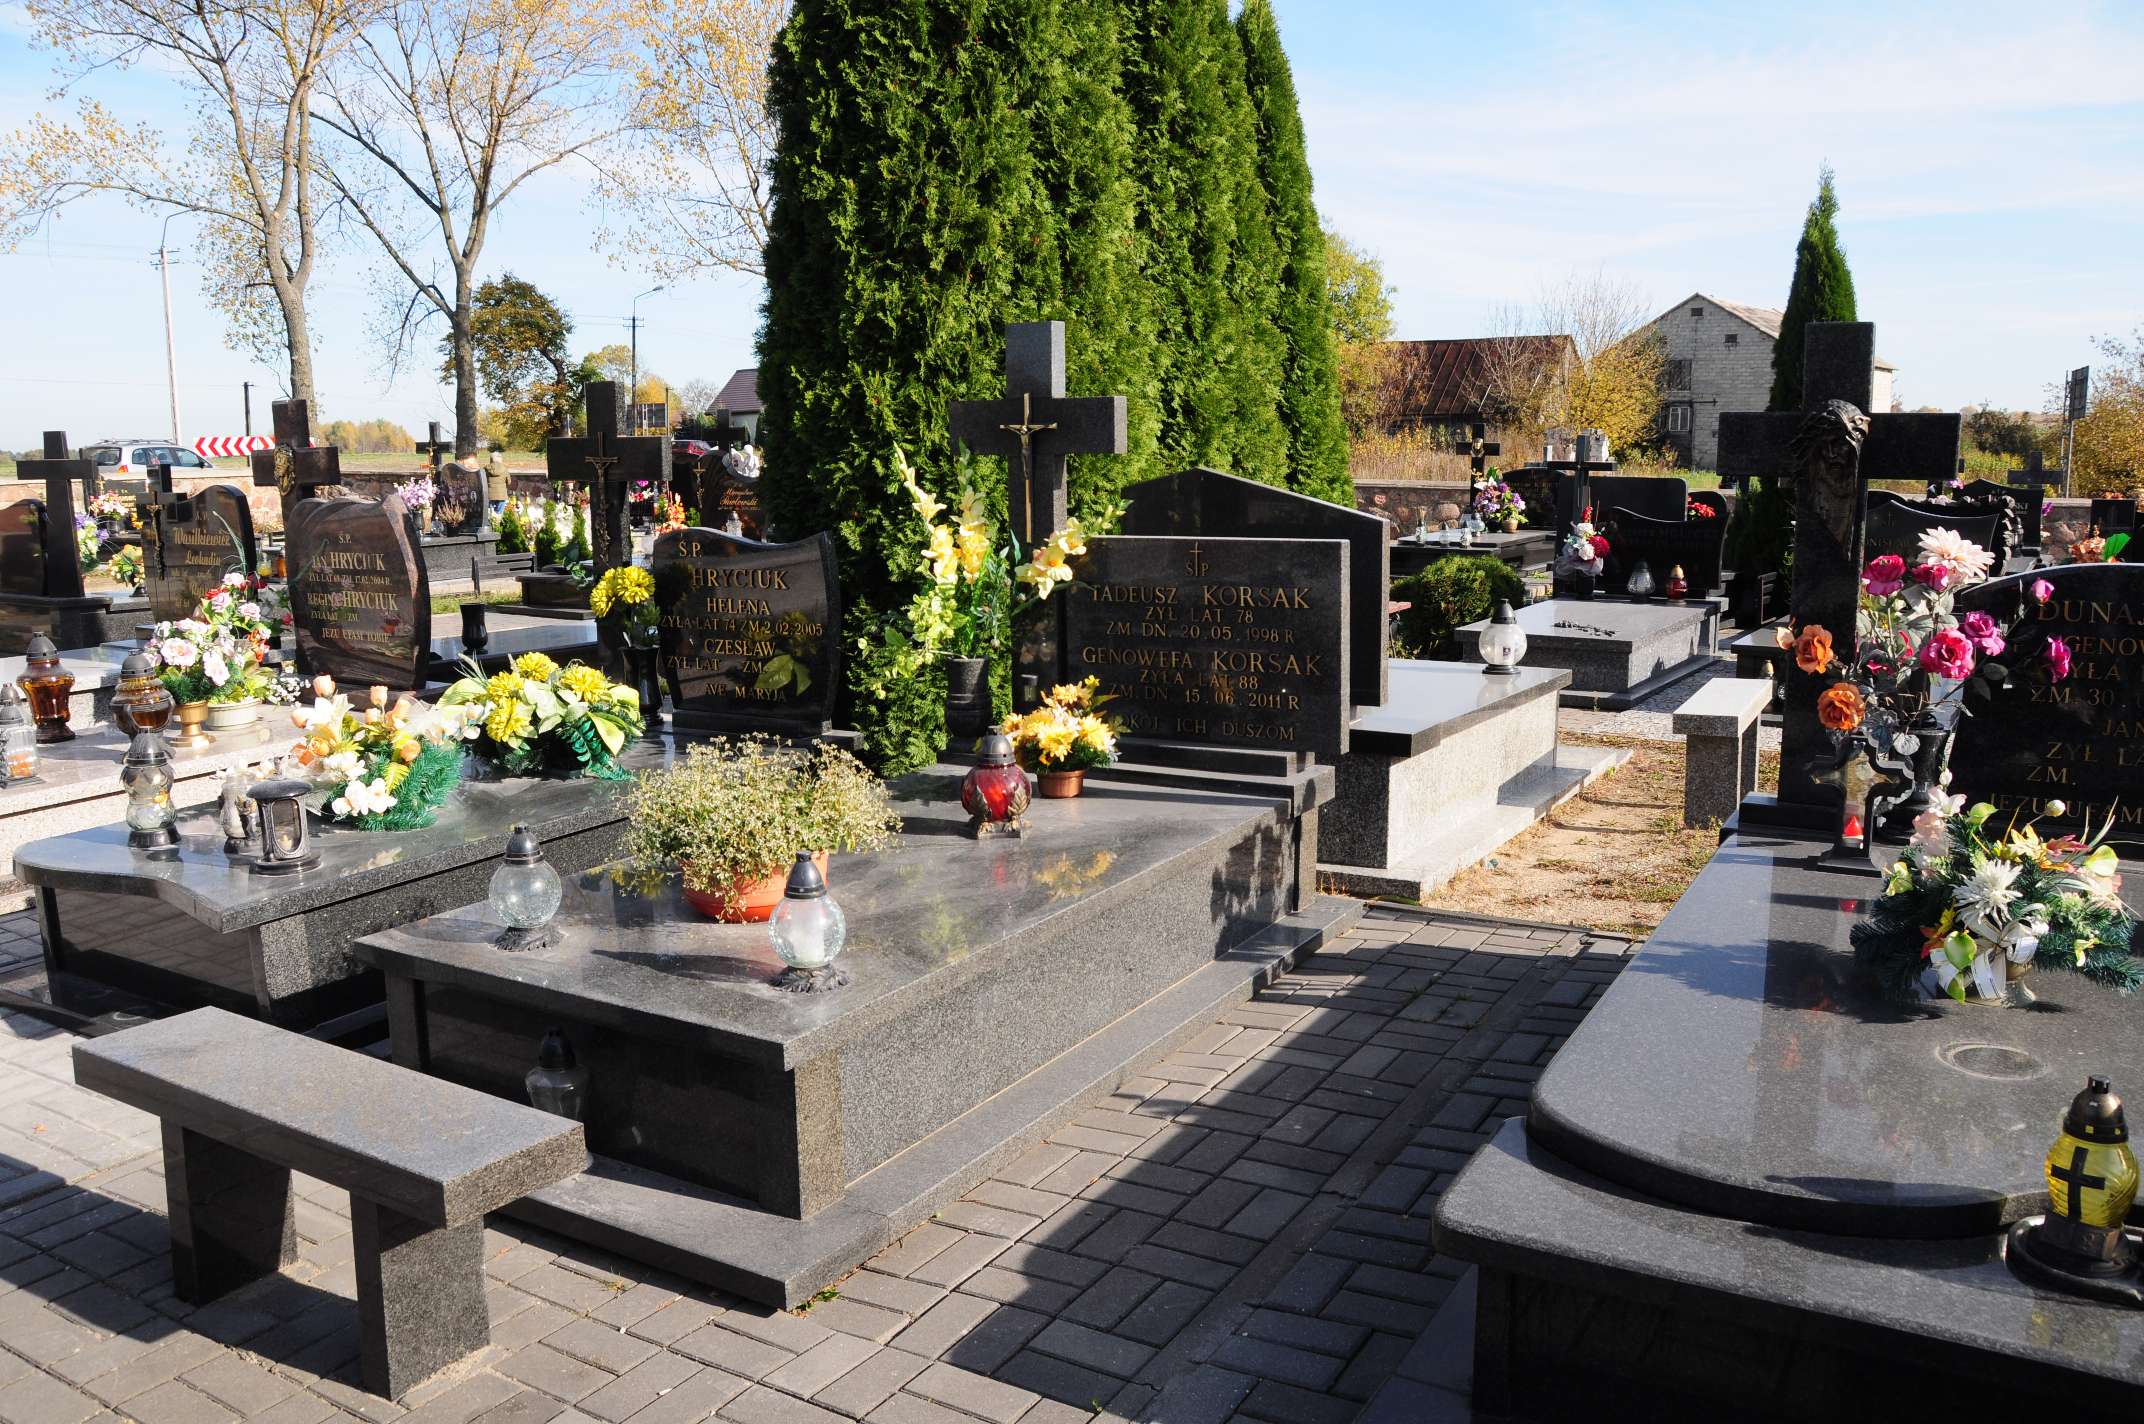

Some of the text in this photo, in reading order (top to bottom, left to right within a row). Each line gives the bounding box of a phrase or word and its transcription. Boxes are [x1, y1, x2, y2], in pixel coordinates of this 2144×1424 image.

[329, 551, 386, 571] HRYCIUK
[692, 568, 790, 591] HRYCIUK
[342, 590, 399, 611] HRYCIUK
[1090, 583, 1312, 609] TADEUSZ KORSAK
[706, 597, 771, 617] HELENA
[1190, 607, 1224, 623] LAT
[1236, 609, 1255, 624] 78
[698, 617, 719, 632] LAT
[724, 619, 737, 632] 74
[703, 638, 777, 657] CZESŁAW
[695, 657, 721, 672] LAT
[1082, 646, 1322, 676] GENOWEFA KORSAK
[2066, 661, 2122, 681] YŁA
[1199, 671, 1231, 688] LAT
[1239, 674, 1259, 690] 88
[734, 685, 788, 703] MARYJA
[1176, 717, 1207, 735] ICH
[1221, 720, 1296, 741] DUSZOM
